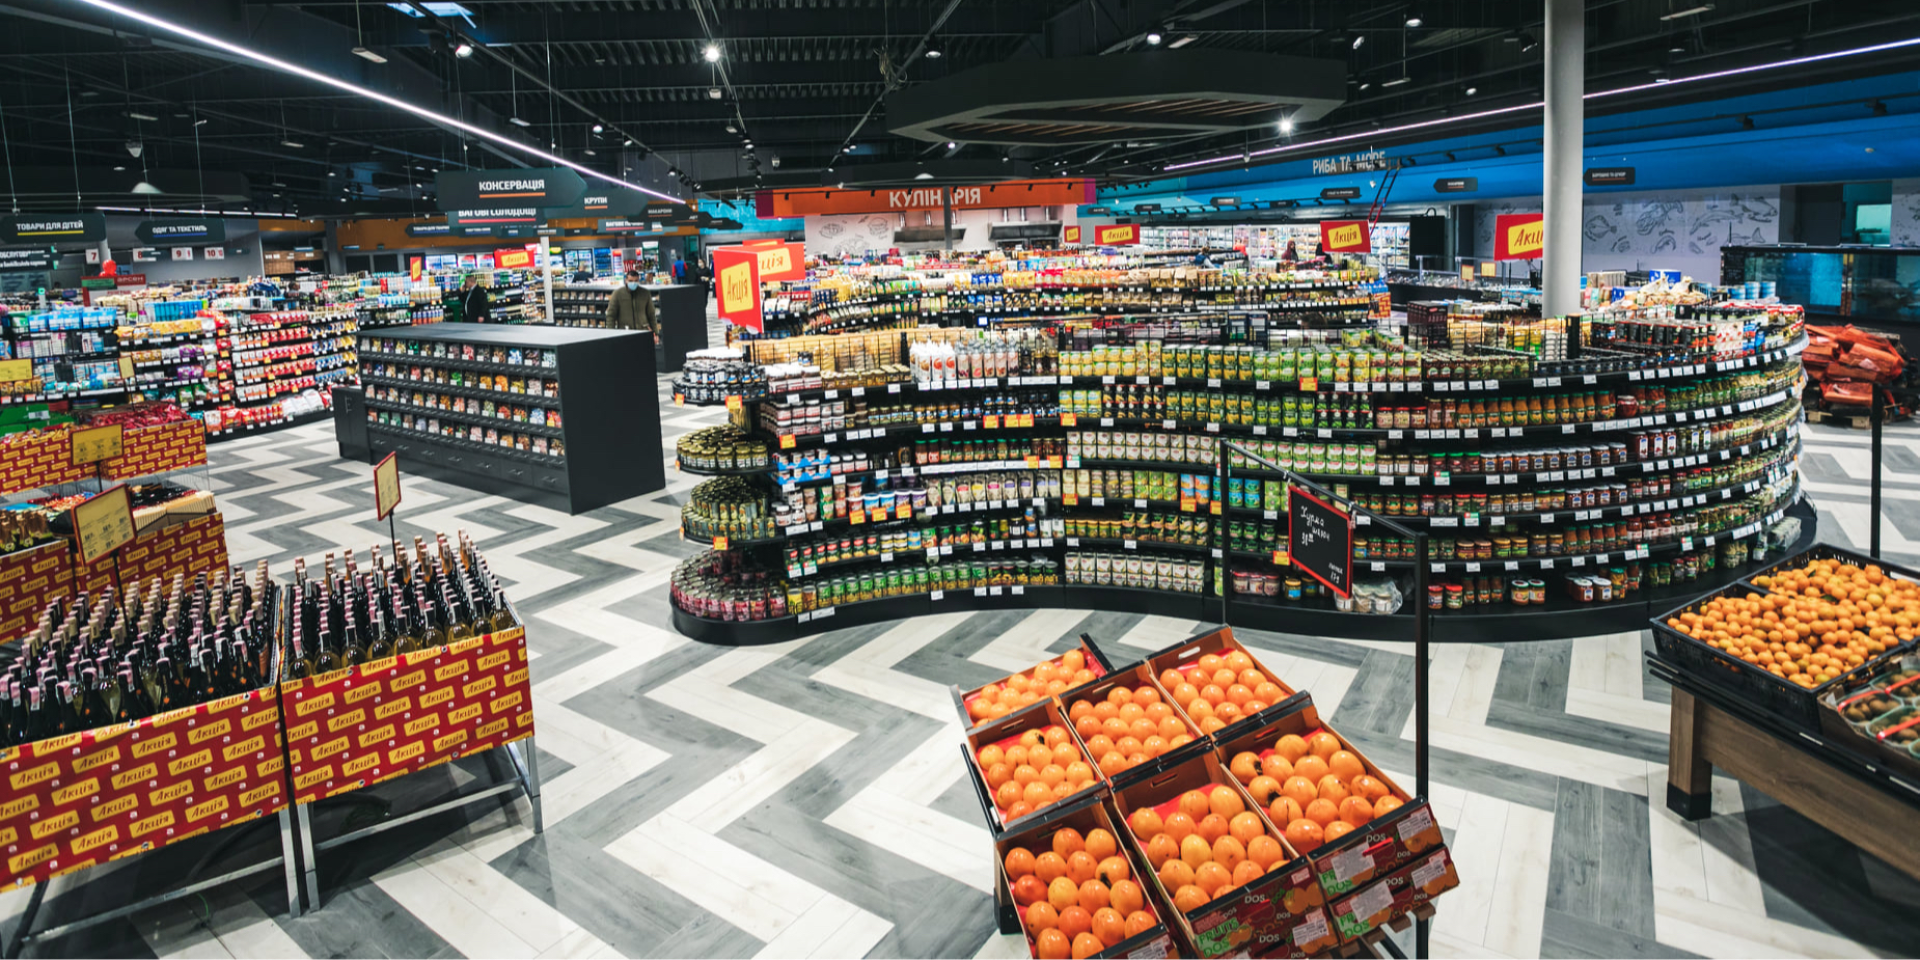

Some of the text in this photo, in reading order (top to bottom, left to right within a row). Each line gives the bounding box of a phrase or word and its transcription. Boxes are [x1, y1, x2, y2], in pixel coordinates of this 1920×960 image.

[1313, 158, 1336, 174] РИБА
[1340, 156, 1352, 172] ТА
[479, 179, 545, 191] КОНСЕРВАЦІЯ
[46, 222, 61, 230] ДЛЯ
[62, 220, 84, 230] ДІТЕЙ
[1333, 229, 1357, 244] Акція
[761, 253, 784, 270] ція
[726, 270, 748, 303] Акція
[483, 654, 506, 666] Акція
[439, 664, 465, 677] Акція
[395, 674, 421, 687] Акція
[468, 680, 492, 693] Акція
[349, 686, 377, 700] Акція
[425, 691, 450, 703] Акція
[301, 697, 330, 712] Акція
[380, 701, 406, 715] Акція
[495, 695, 519, 708] Акція
[247, 710, 278, 726] Акція
[333, 713, 361, 728] Акція
[454, 707, 478, 719] Акція
[194, 723, 225, 740] Акція
[409, 718, 435, 731] Акція
[481, 722, 504, 734] Акція
[364, 729, 391, 742] Акція
[438, 734, 464, 748] Акція
[138, 737, 171, 753] Акція
[229, 740, 259, 756] Акція
[317, 741, 345, 756] Акція
[395, 745, 420, 758] Акція
[79, 750, 114, 770] Акція
[174, 754, 207, 771] Акція
[348, 757, 375, 771] Акція
[18, 767, 54, 784] Акція
[118, 768, 152, 784] Акція
[210, 771, 241, 787] Акція
[300, 770, 328, 786] Акція
[58, 783, 93, 800] Акція
[156, 785, 188, 801] Акція
[245, 786, 275, 802] Акція
[98, 799, 132, 816] Акція
[191, 800, 223, 818] Акція
[39, 816, 73, 832] Акція
[136, 815, 169, 832] Акція
[78, 831, 112, 848] Акція
[1366, 833, 1386, 843] DOS
[17, 848, 53, 868] Акція
[1244, 894, 1266, 904] DOS
[1276, 912, 1291, 920] DOS
[1199, 918, 1239, 945] FRUITS
[1344, 920, 1369, 939] DOS
[1259, 933, 1280, 943] DOS
[1203, 936, 1230, 958] DOS
